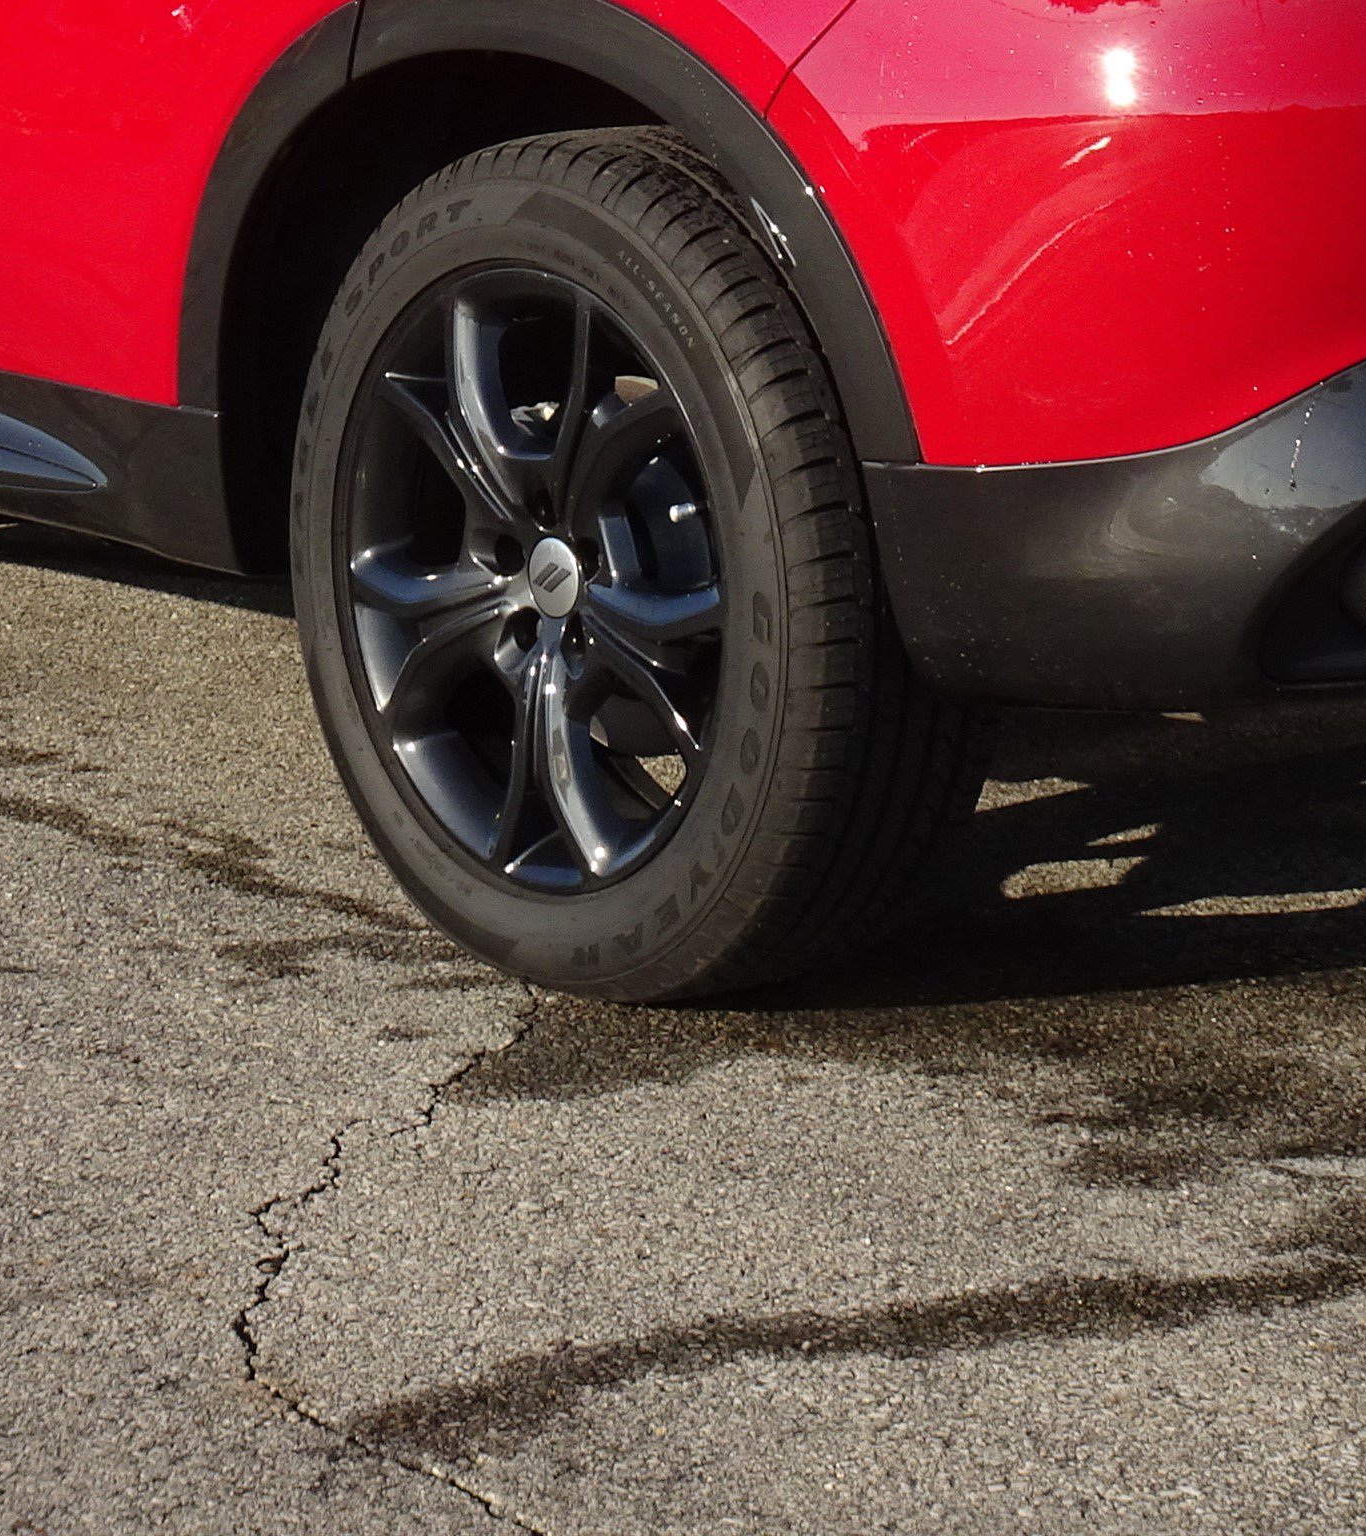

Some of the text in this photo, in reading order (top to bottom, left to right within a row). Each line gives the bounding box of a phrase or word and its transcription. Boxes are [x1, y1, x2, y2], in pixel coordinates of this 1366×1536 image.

[343, 198, 474, 317] SPORT
[615, 249, 697, 349] ALL-SEASON
[570, 590, 774, 967] GOODYEAR
